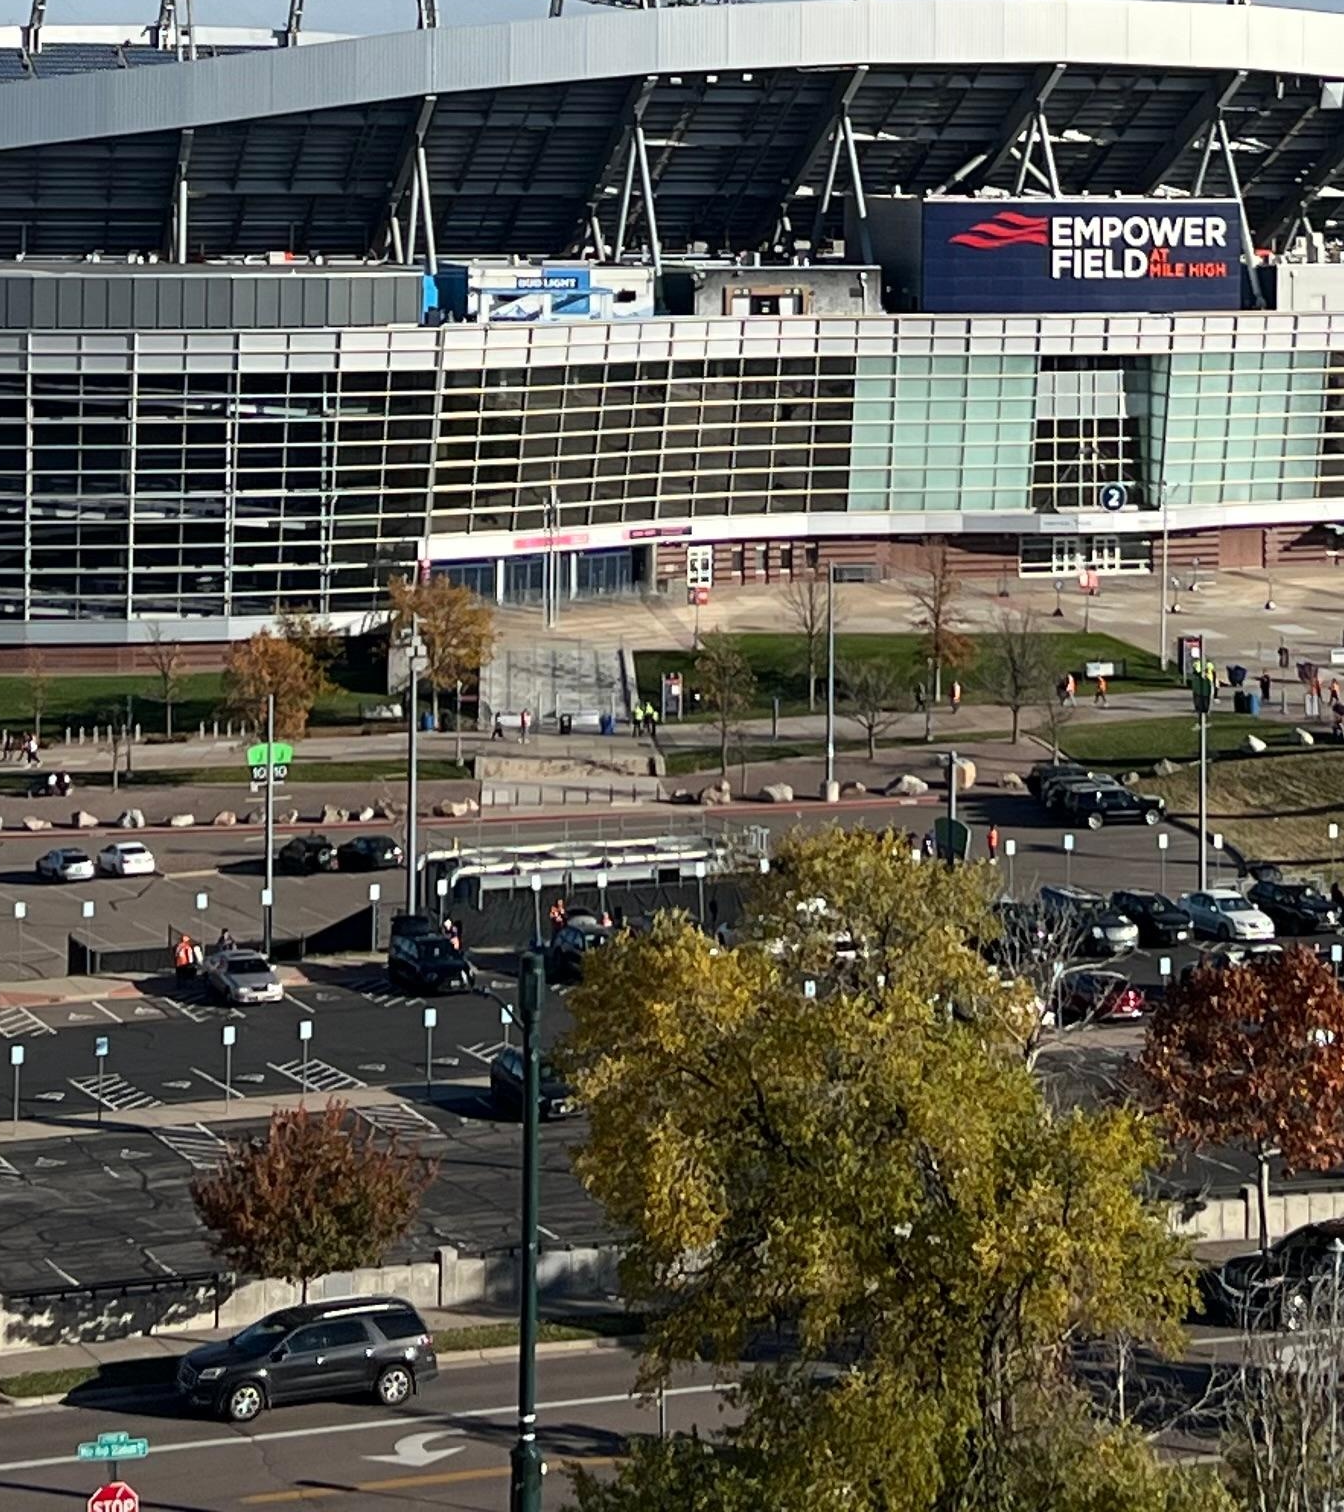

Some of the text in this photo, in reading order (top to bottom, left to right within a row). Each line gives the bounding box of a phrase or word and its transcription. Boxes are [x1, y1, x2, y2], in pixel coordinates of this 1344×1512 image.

[1052, 216, 1227, 247] EMPOWER
[1150, 248, 1169, 262] AT
[1052, 249, 1148, 279] FIELD
[1150, 262, 1226, 278] MILE HIGH
[518, 278, 577, 288] BUD LIGHT
[1108, 488, 1121, 507] 2
[93, 1498, 135, 1512] STOP
